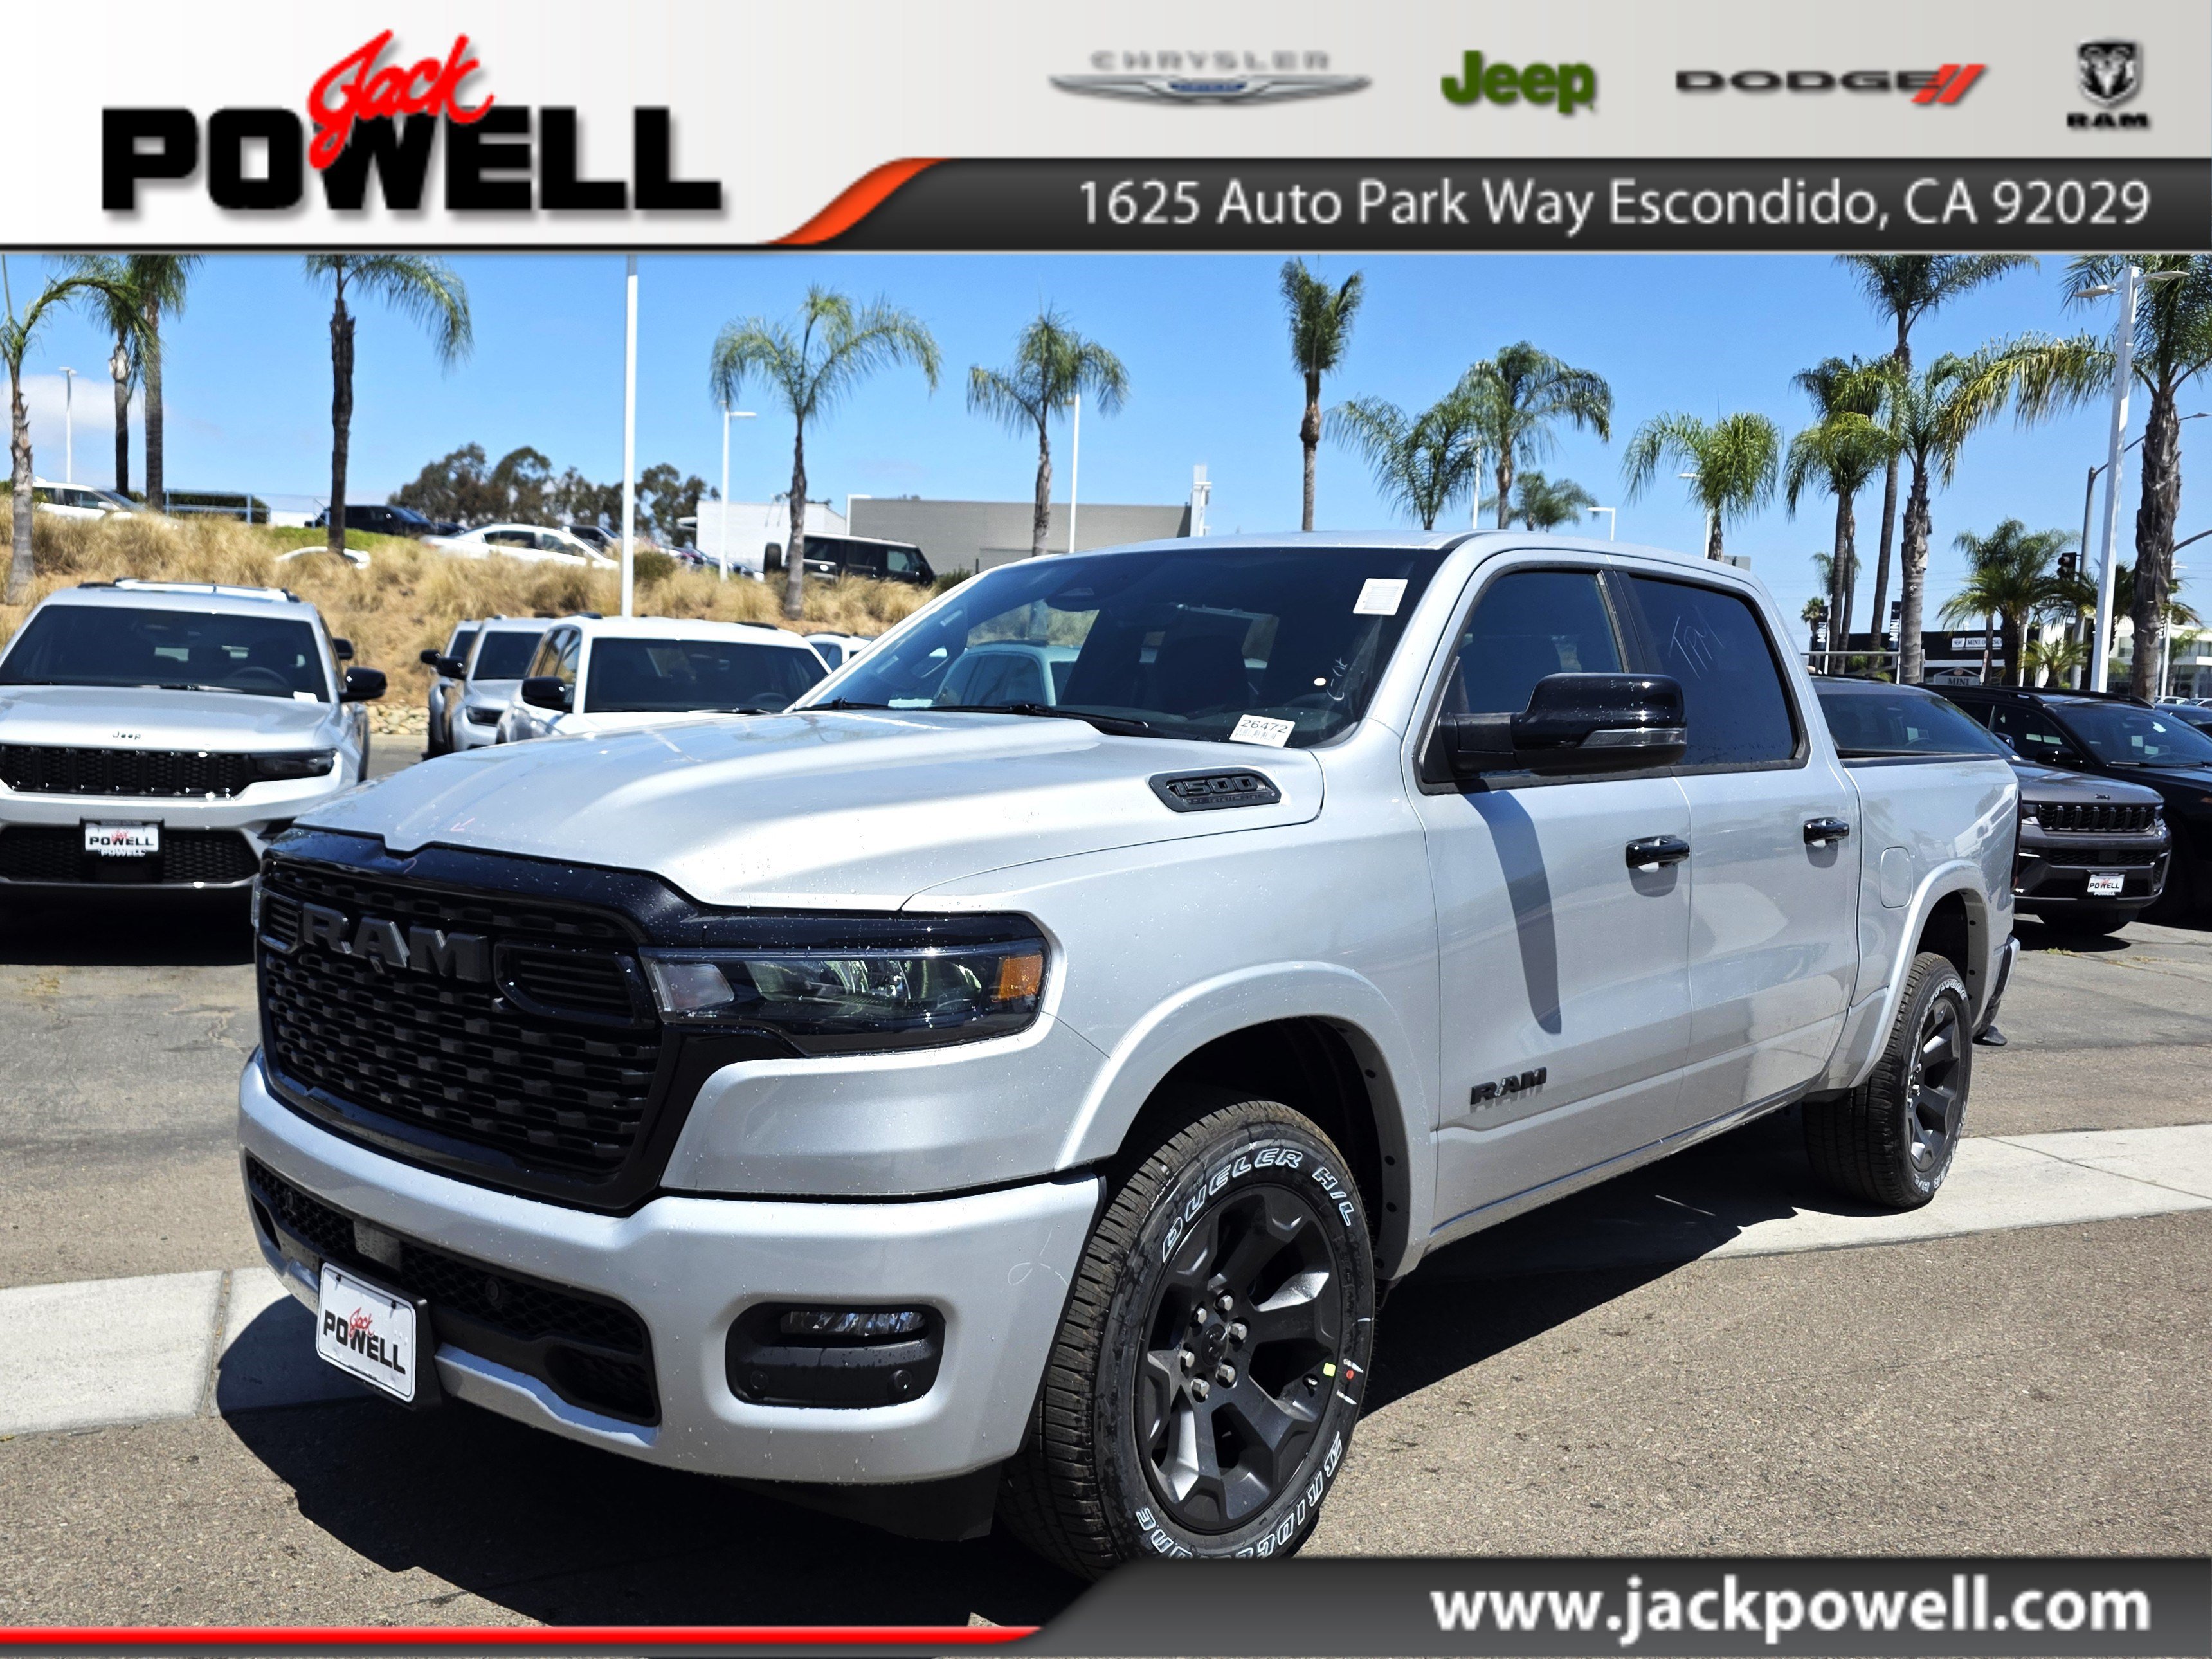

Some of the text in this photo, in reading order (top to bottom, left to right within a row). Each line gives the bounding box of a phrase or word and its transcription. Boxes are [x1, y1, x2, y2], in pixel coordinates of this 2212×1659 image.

[1889, 619, 1900, 642] MINI
[1948, 678, 1970, 686] MINI
[113, 731, 141, 741] Jeep
[1240, 719, 1289, 734] 26472
[1174, 776, 1258, 797] 1500
[89, 837, 154, 846] POWELL
[302, 902, 491, 983] RAM
[1470, 1066, 1547, 1105] RAM
[1163, 1148, 1303, 1263] DUELER
[349, 1307, 375, 1339] Jack
[323, 1309, 406, 1375] POWELL
